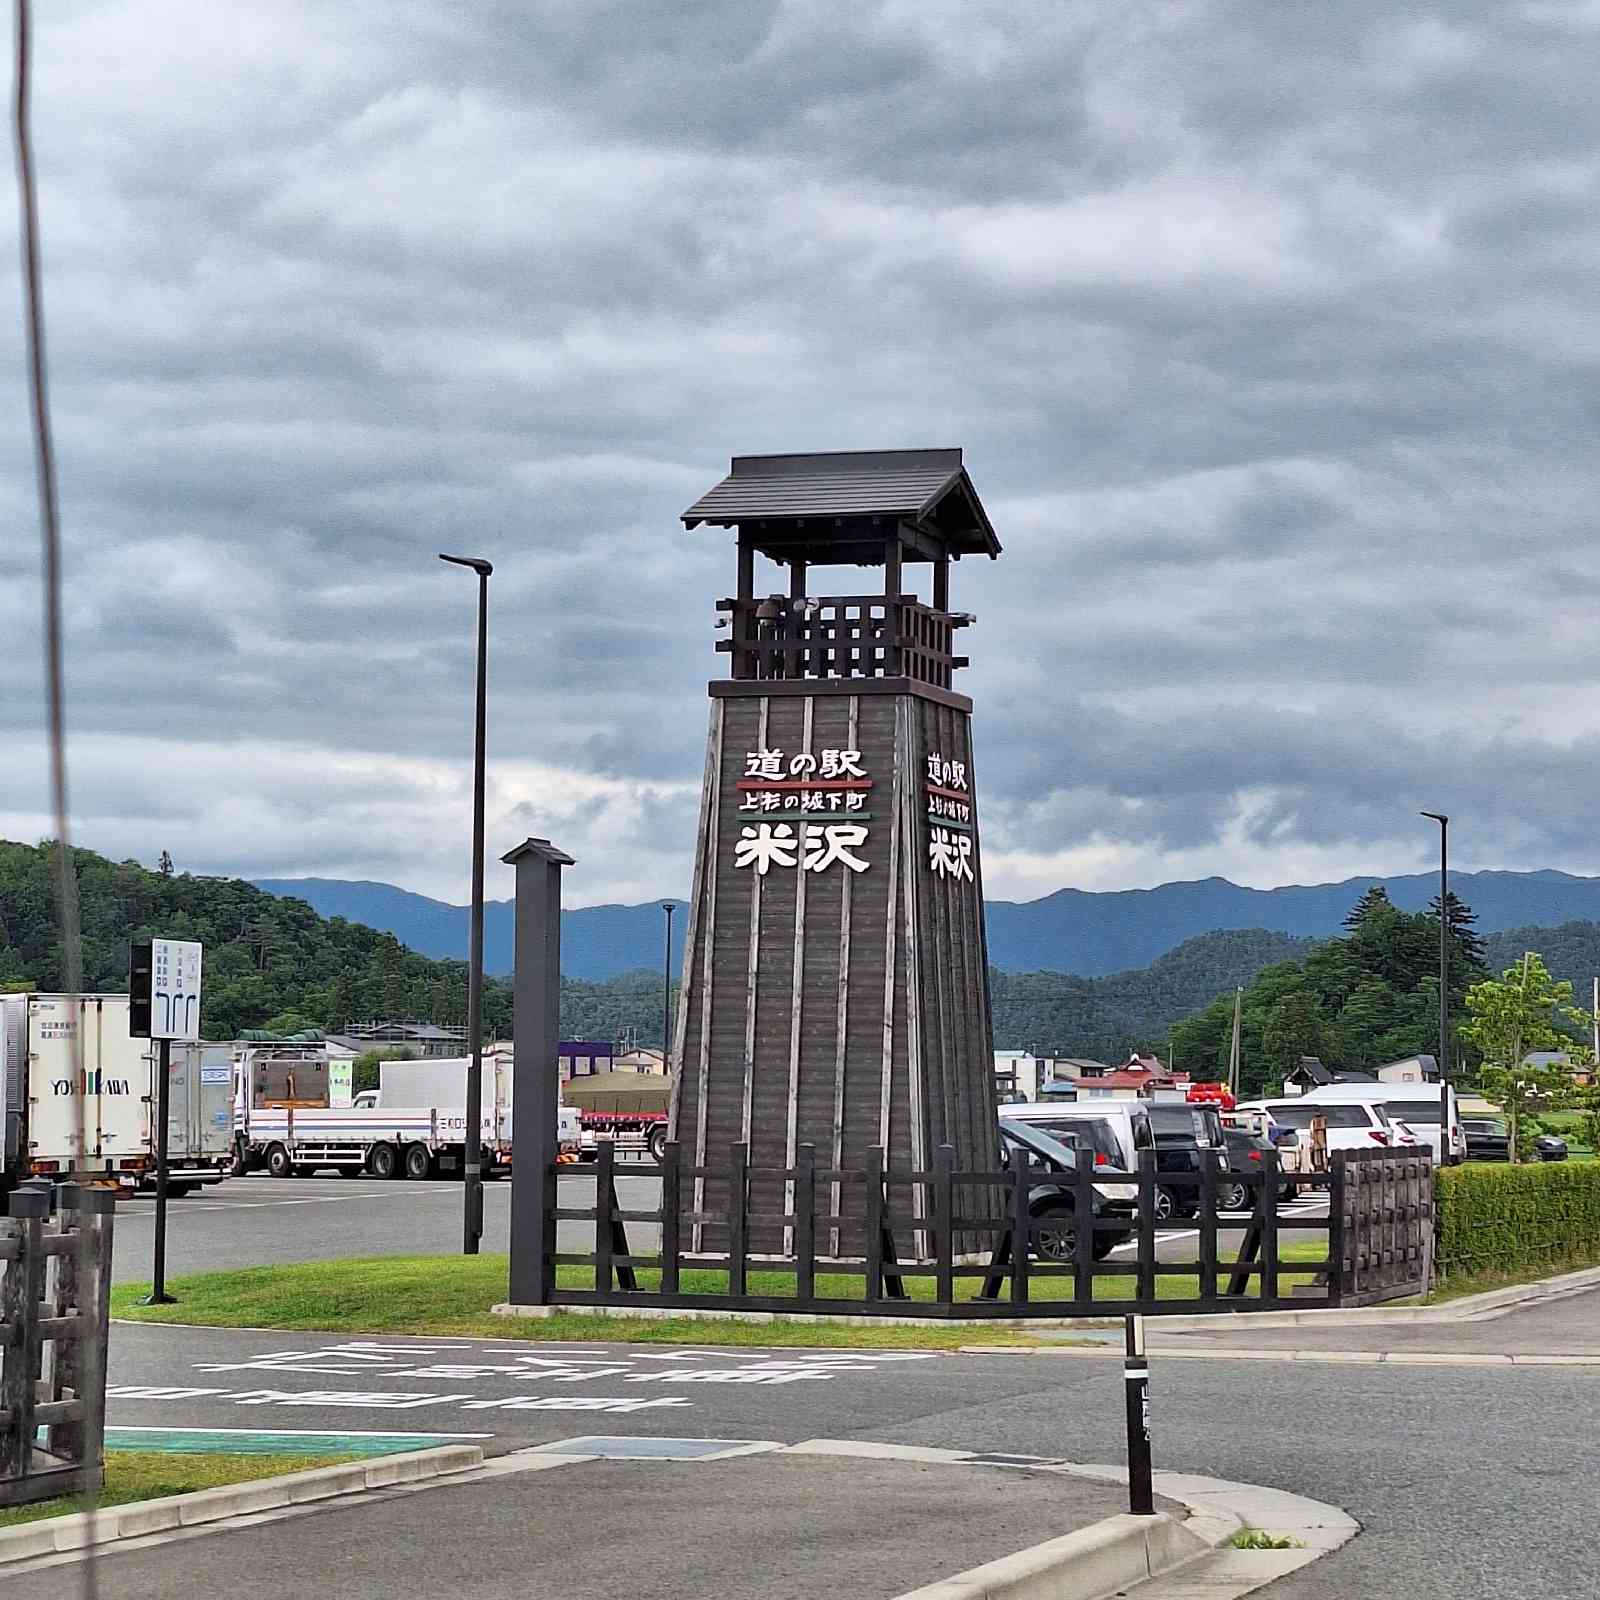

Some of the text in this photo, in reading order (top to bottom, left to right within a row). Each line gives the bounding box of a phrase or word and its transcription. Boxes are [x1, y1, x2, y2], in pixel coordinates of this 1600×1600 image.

[744, 748, 868, 781] 道の駅
[927, 752, 968, 791] 道の駅
[738, 791, 868, 811] 上杉の城下町
[734, 823, 870, 875] 米沢
[929, 826, 974, 883] 米沢
[191, 1361, 837, 1384] 大型車
